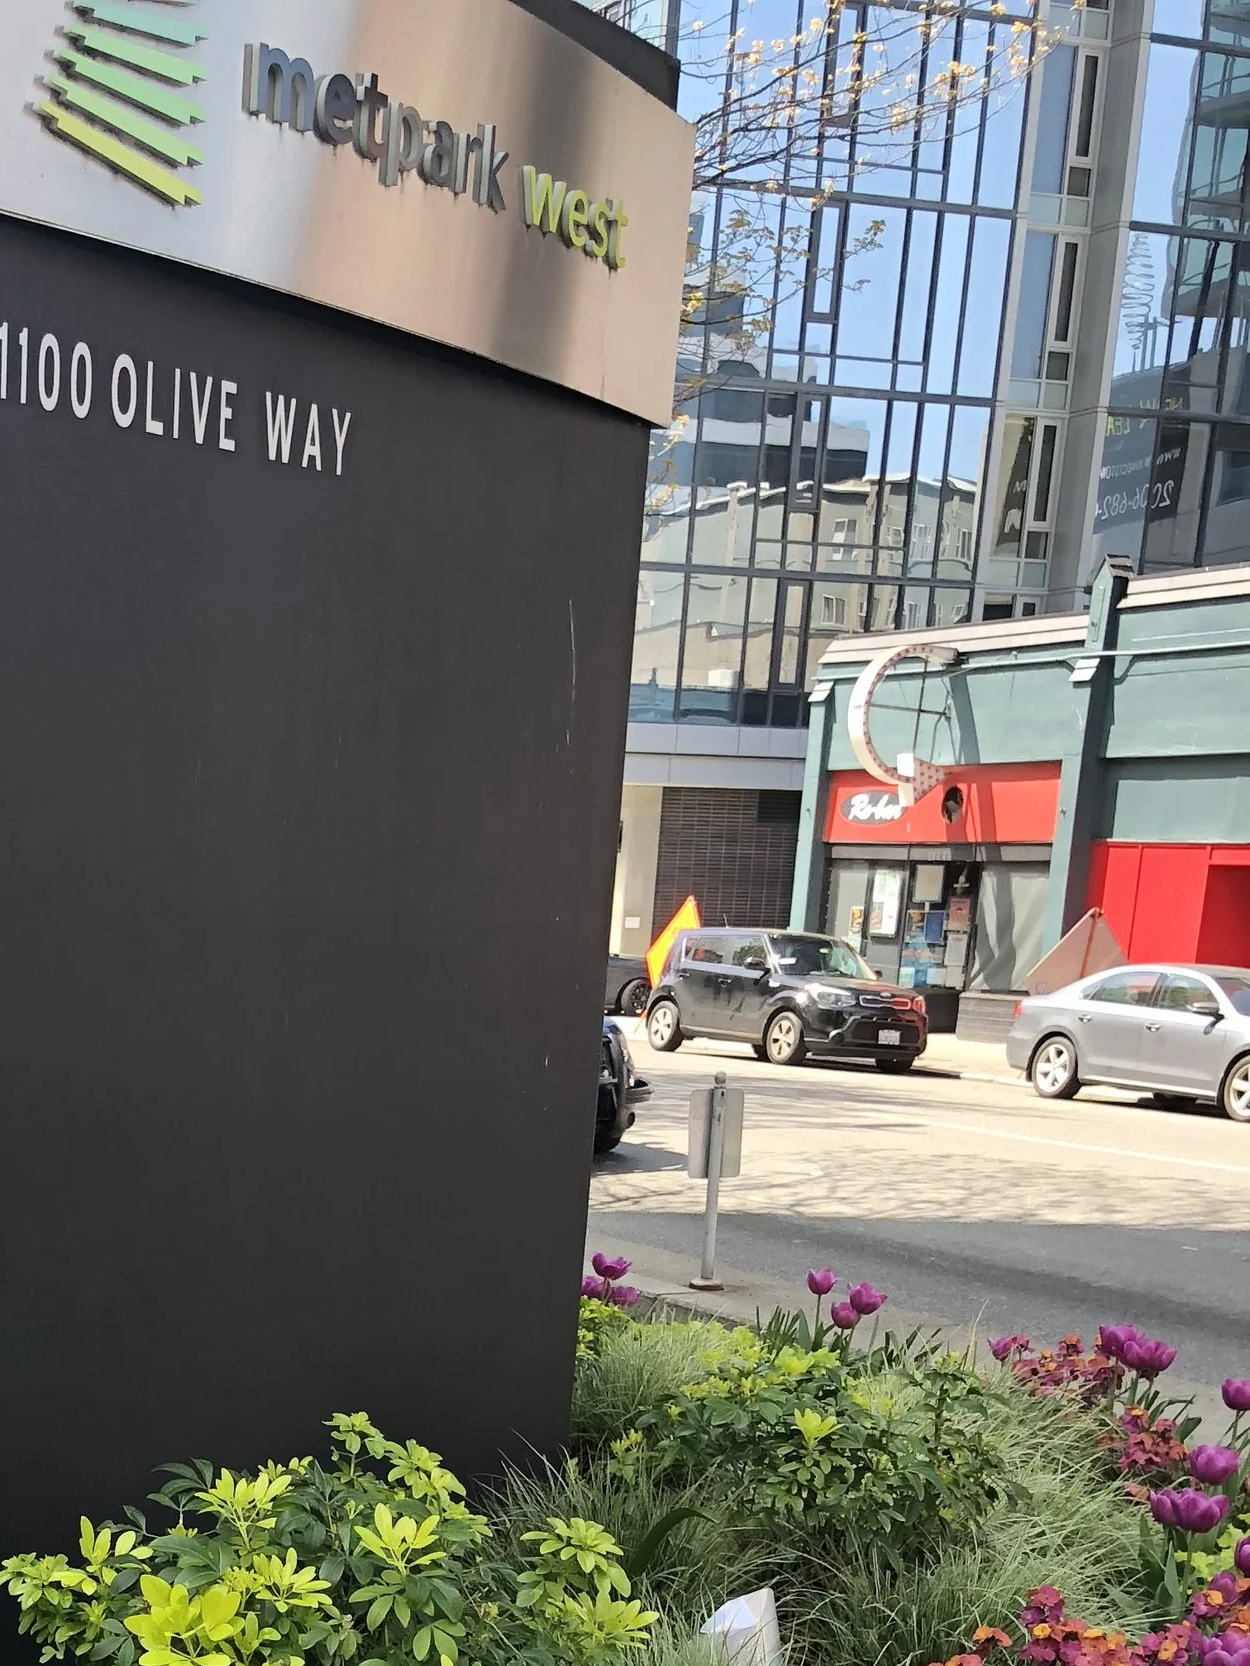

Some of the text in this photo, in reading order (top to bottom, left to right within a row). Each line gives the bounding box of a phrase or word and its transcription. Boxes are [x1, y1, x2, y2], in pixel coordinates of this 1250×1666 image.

[244, 42, 630, 269] metpark west
[111, 353, 238, 452] OLIVE
[265, 390, 352, 476] WAY
